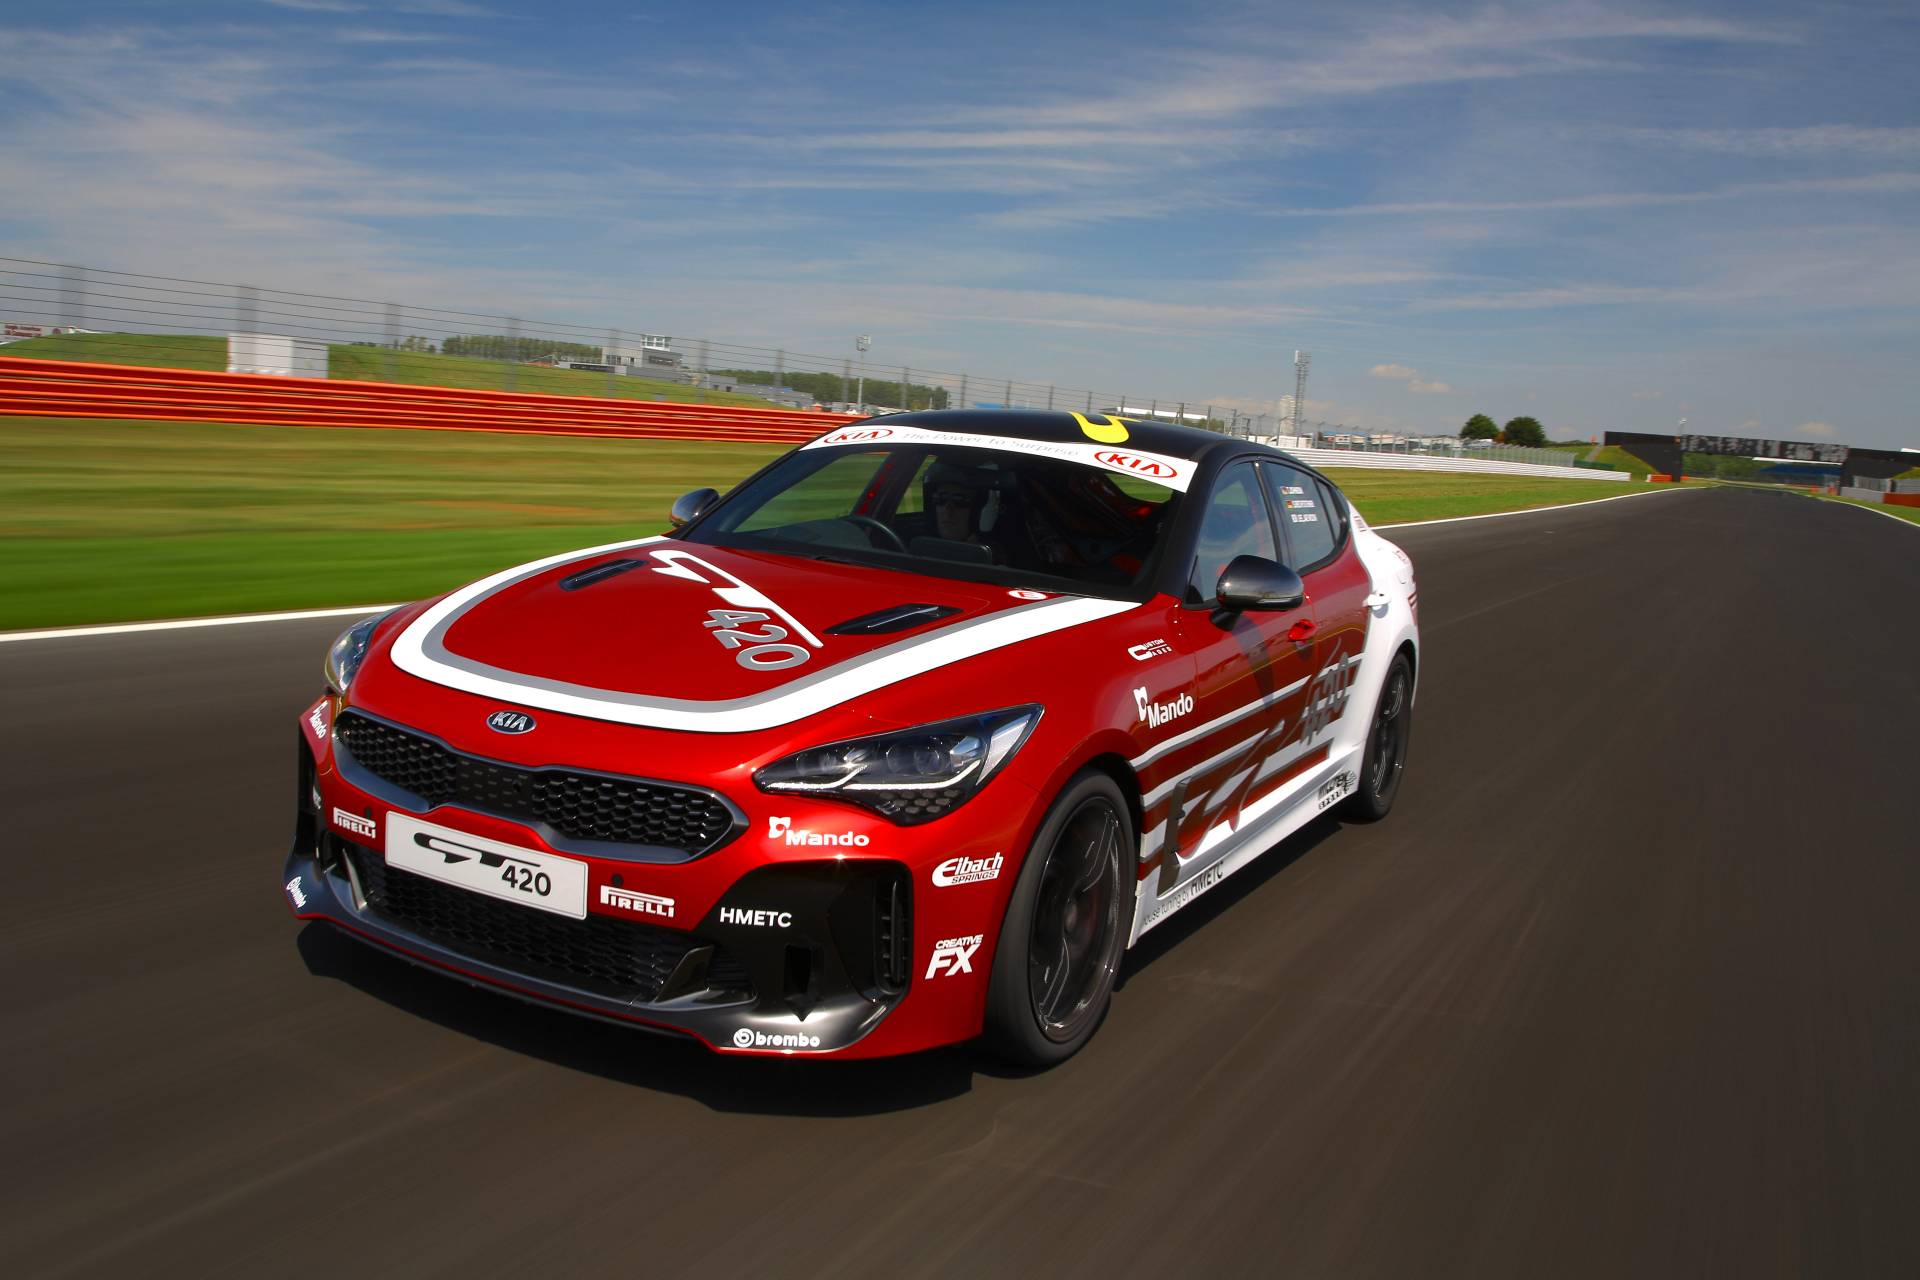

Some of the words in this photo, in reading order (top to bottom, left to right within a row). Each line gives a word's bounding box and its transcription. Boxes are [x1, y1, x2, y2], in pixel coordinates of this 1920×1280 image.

[837, 430, 880, 441] KIA
[1107, 453, 1161, 476] KIA
[702, 609, 811, 671] 420
[490, 711, 526, 731] KIA
[1147, 692, 1194, 729] Mando
[333, 807, 376, 838] PIRELLI
[785, 830, 870, 847] Mando
[501, 865, 552, 897] 420
[931, 851, 1004, 887] Eibach
[951, 870, 996, 884] SPRINGS
[1190, 860, 1224, 897] HMETC
[600, 885, 675, 918] PIRELLI
[720, 907, 792, 928] HMETC
[935, 934, 983, 950] CREATIVE
[924, 943, 981, 980] FX
[755, 1031, 821, 1048] brembo
